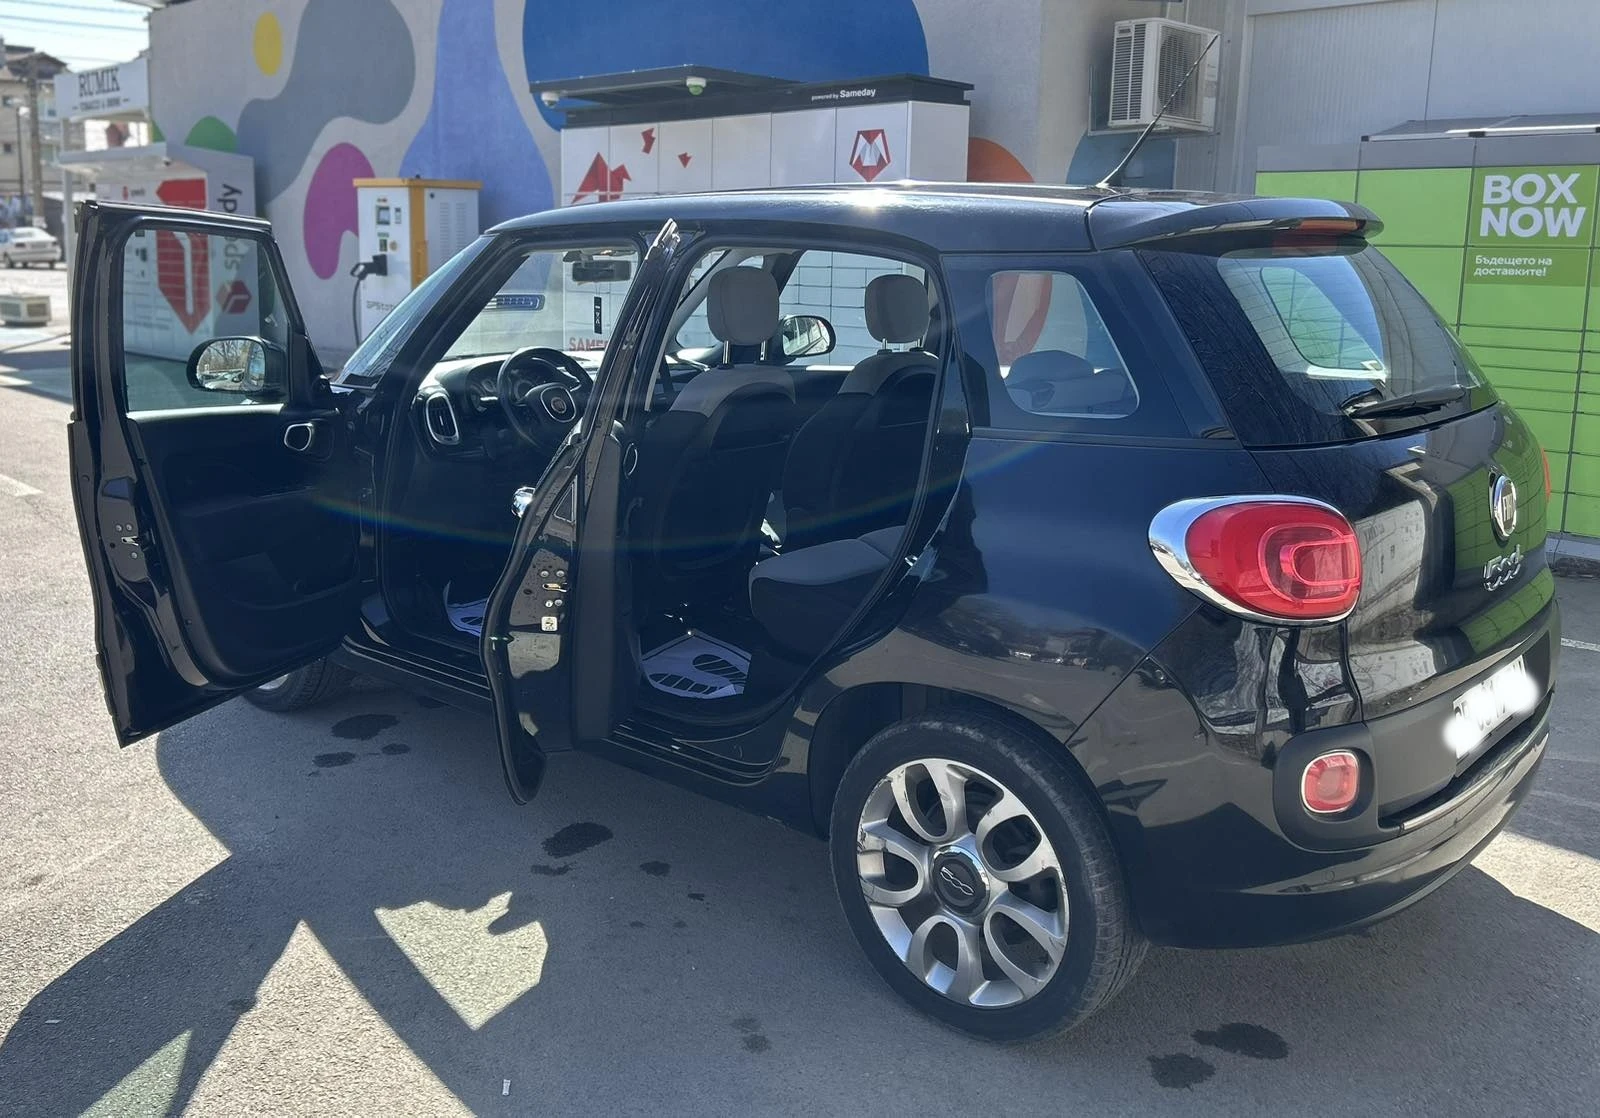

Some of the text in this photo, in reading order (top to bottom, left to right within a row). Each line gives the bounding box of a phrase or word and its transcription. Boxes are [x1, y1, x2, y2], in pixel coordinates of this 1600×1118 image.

[79, 67, 120, 97] RUMIK
[840, 88, 876, 98] Sameday
[1483, 173, 1580, 205] BOX
[1480, 207, 1586, 237] NOW
[1474, 267, 1546, 276] доставките!
[1475, 255, 1553, 267] Бъдещето на
[940, 867, 975, 896] 500
